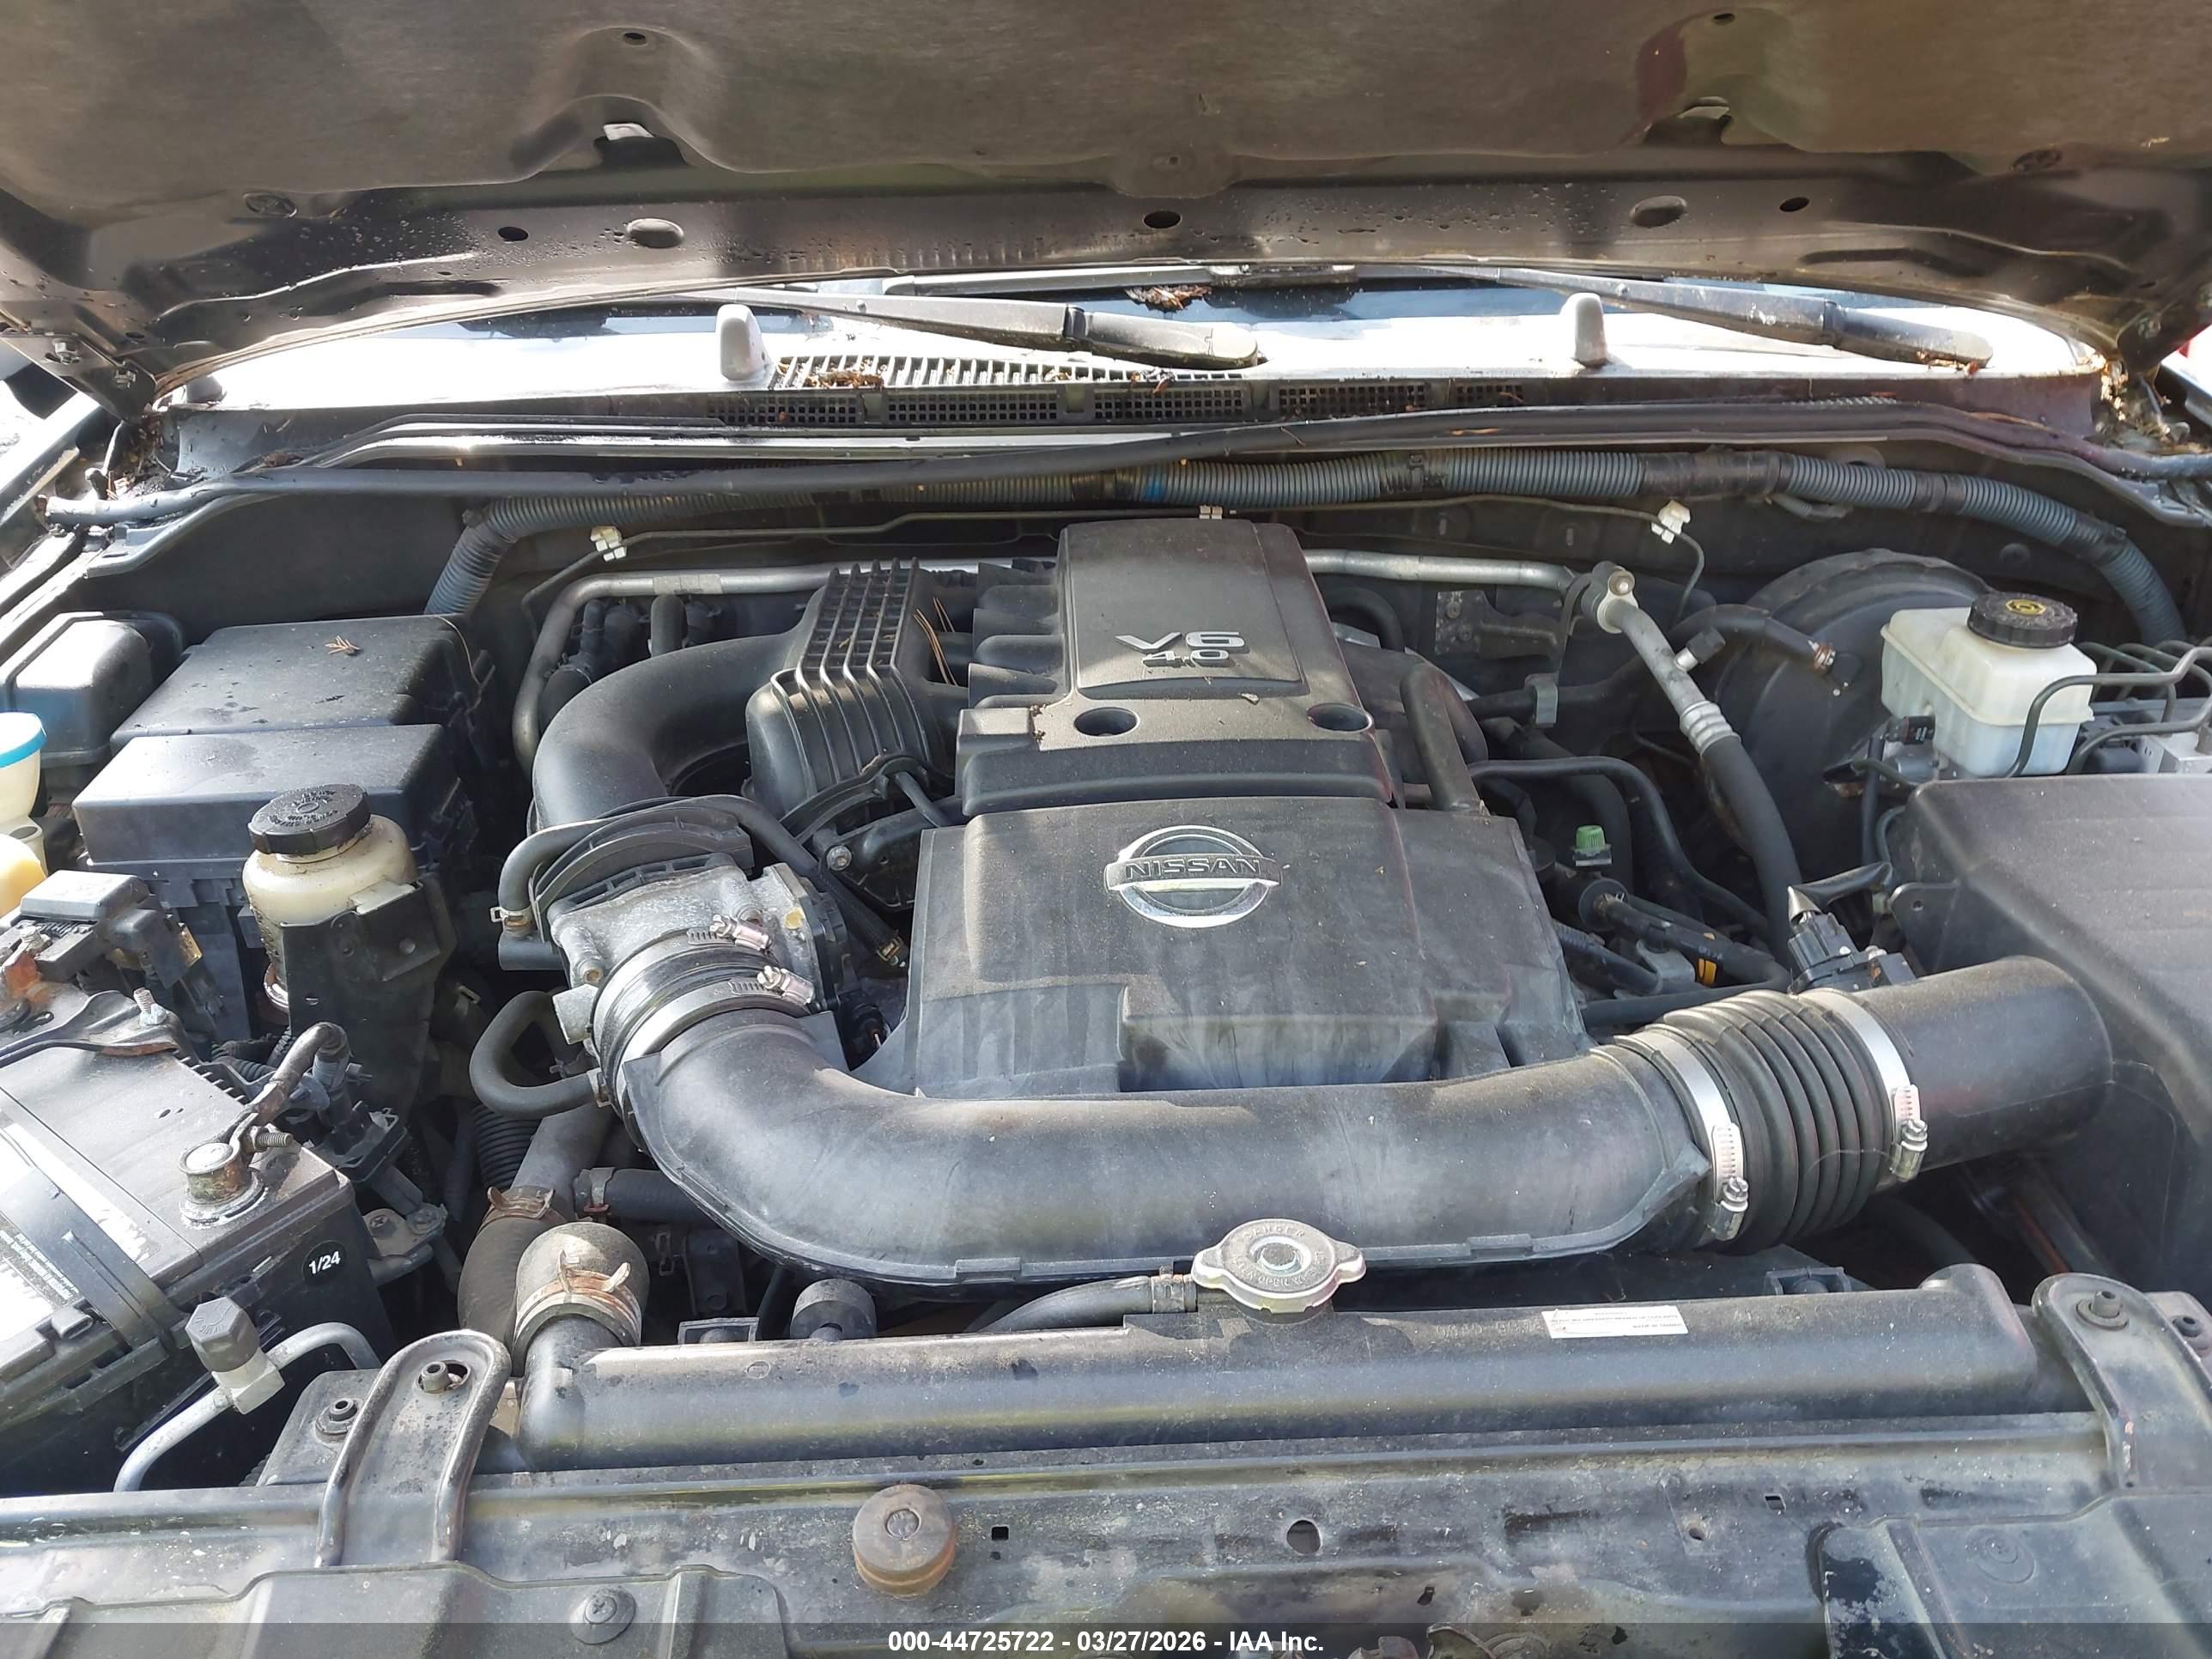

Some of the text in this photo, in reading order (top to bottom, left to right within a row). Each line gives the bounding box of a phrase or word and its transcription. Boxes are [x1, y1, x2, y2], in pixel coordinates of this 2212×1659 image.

[1115, 631, 1246, 651] V6
[1140, 648, 1231, 666] 4.0
[1125, 858, 1261, 879] NISSAN
[308, 1250, 341, 1274] 1/24
